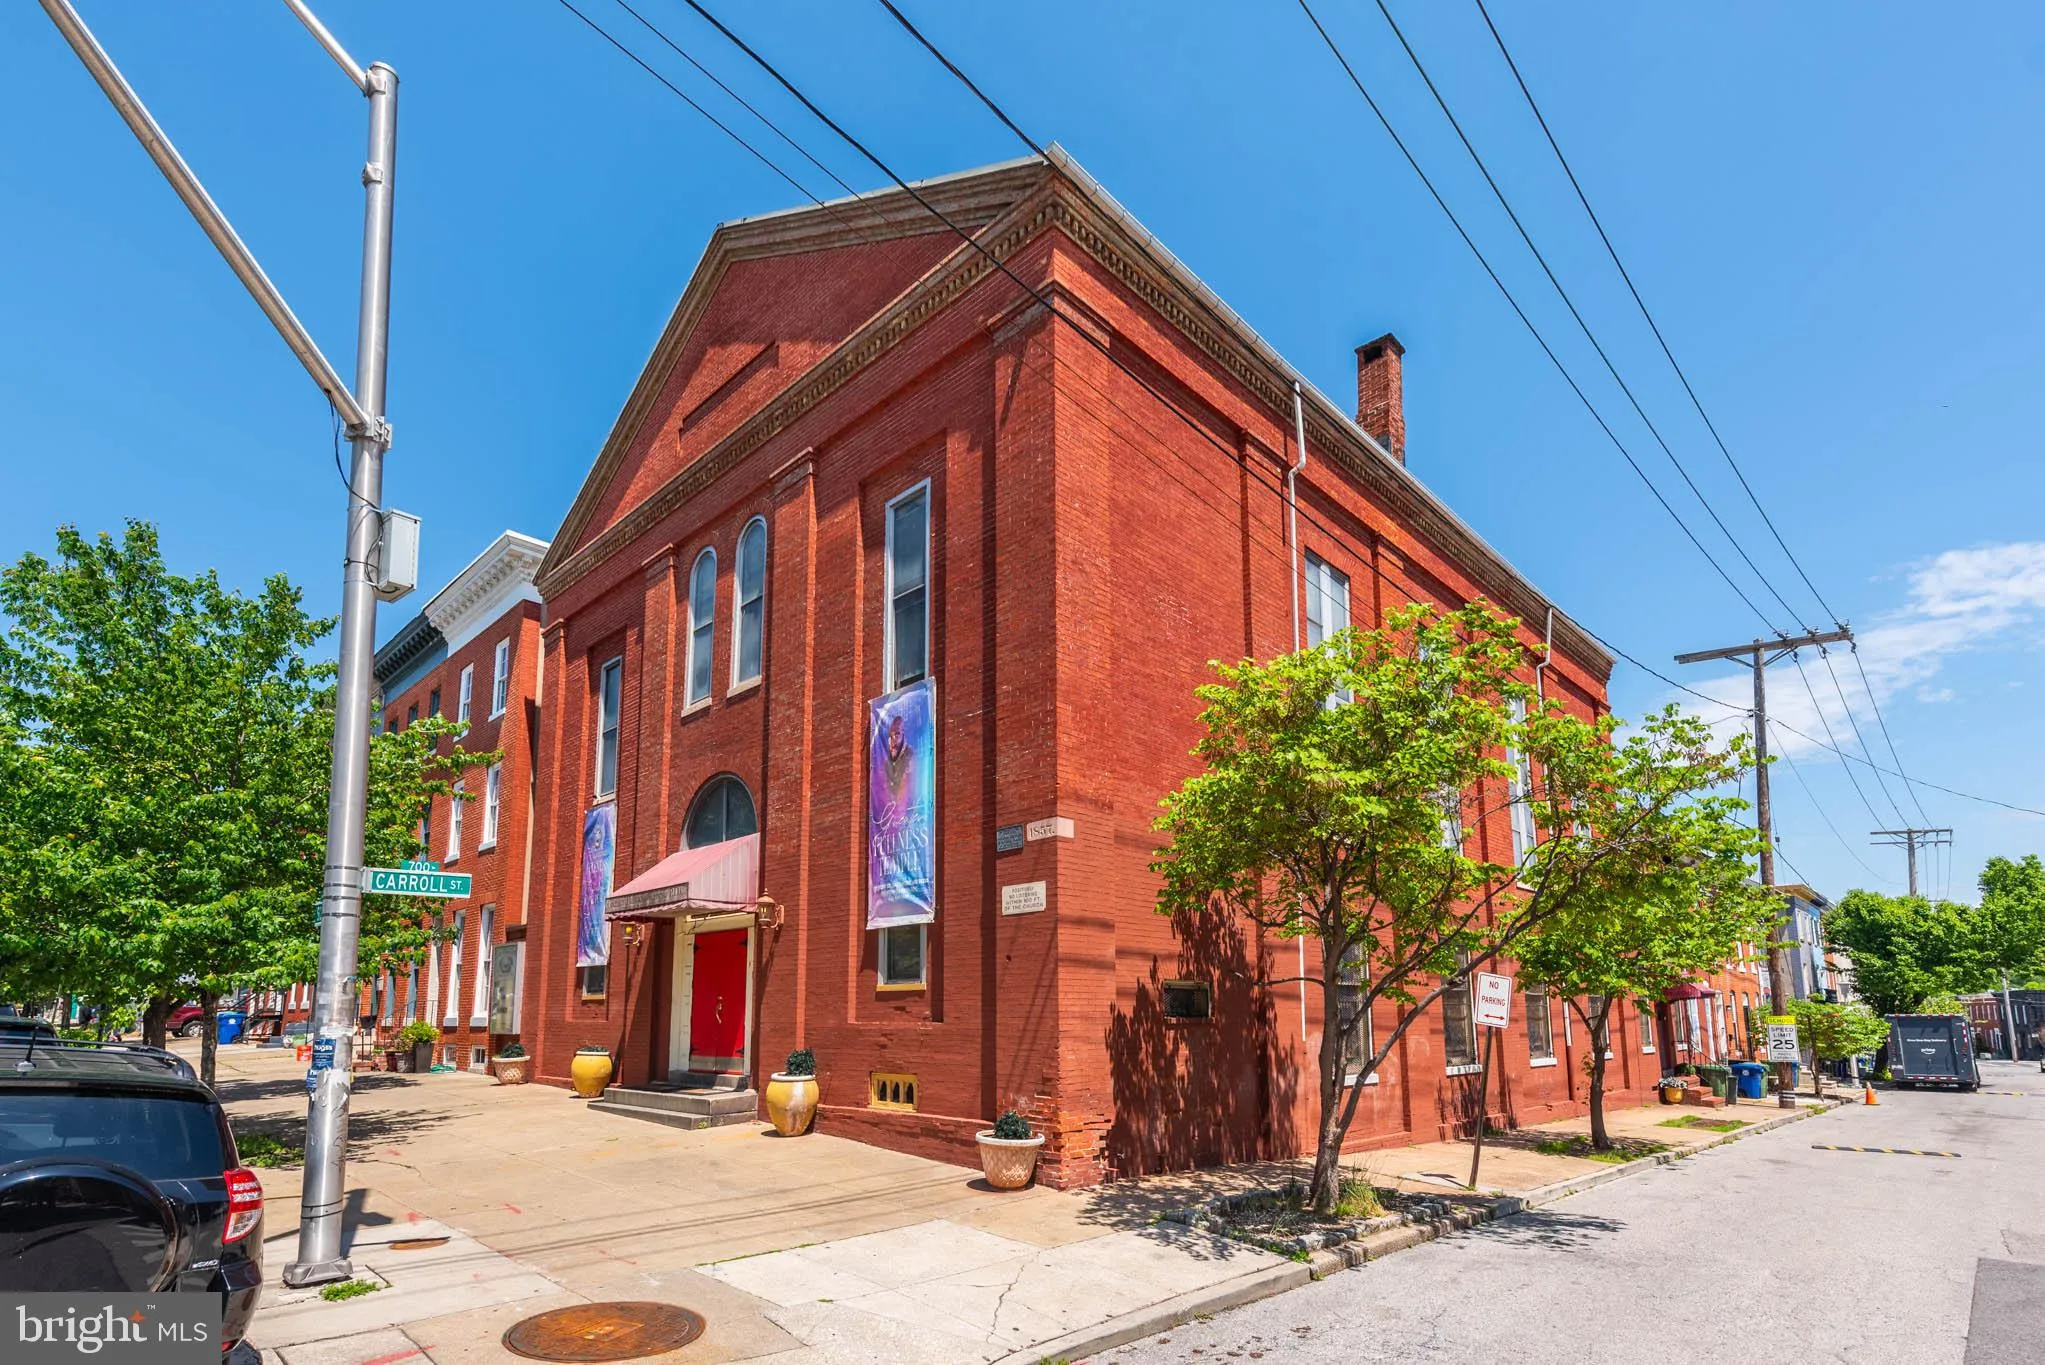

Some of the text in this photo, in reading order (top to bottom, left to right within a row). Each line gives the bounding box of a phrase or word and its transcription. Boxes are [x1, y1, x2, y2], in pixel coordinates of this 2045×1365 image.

[408, 861, 431, 872] 700
[375, 873, 448, 892] CARROLL
[1489, 980, 1499, 990] NO
[1481, 995, 1506, 1007] PARKING
[1772, 1039, 1795, 1050] 25
